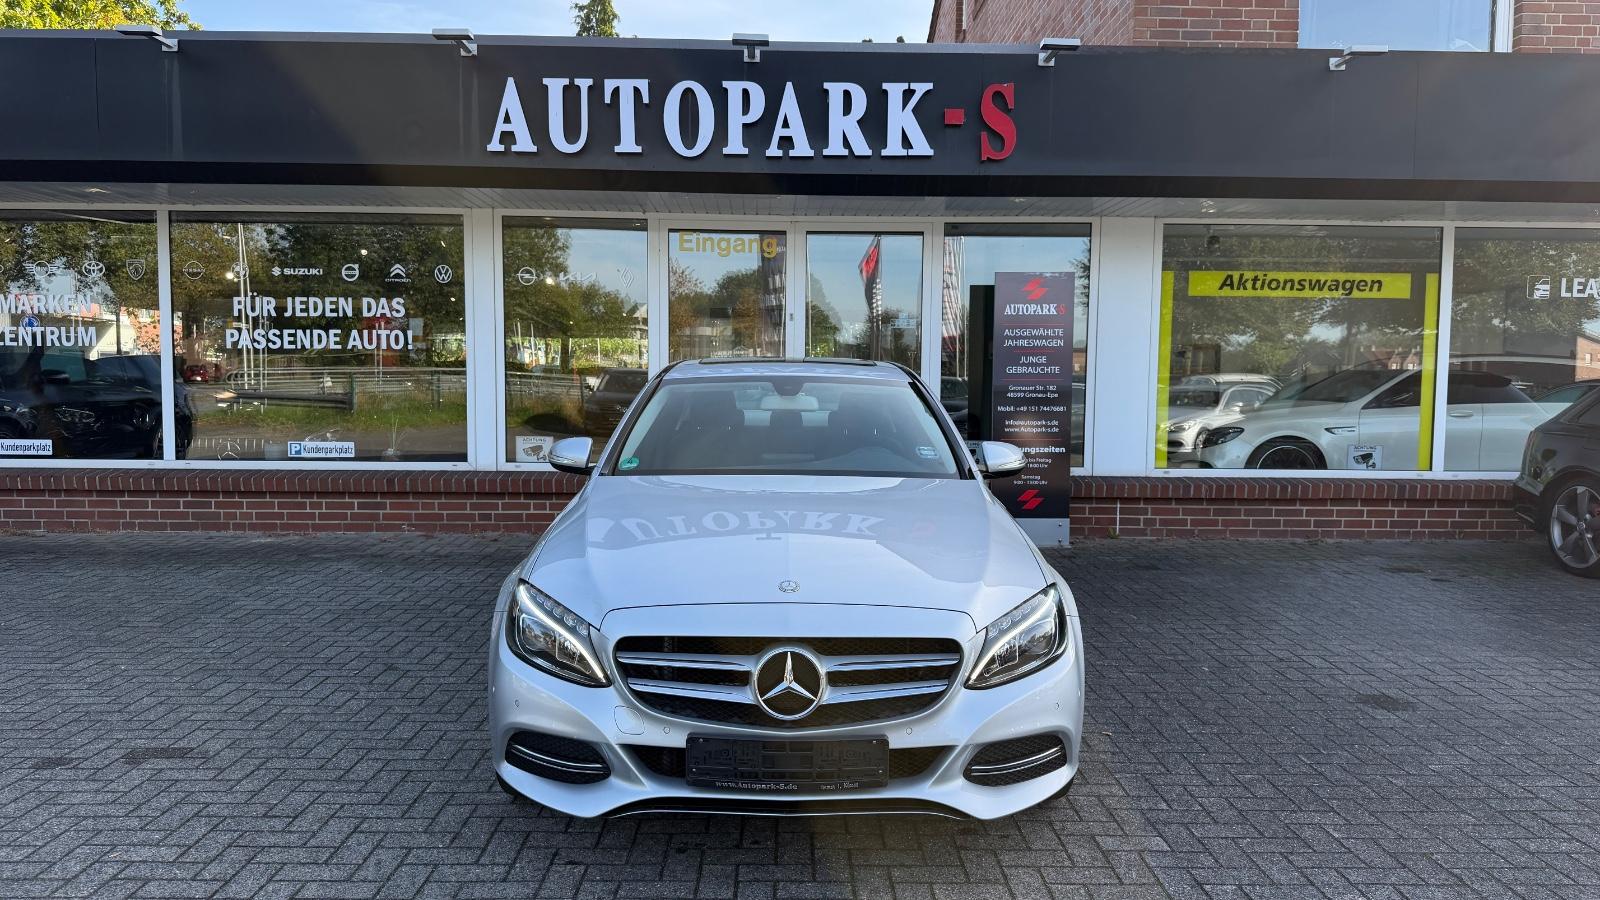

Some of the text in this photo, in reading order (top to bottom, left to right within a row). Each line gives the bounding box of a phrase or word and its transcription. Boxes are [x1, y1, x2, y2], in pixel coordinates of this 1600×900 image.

[679, 231, 778, 258] Eingang
[283, 266, 323, 276] SUZUKI
[1218, 272, 1383, 297] Aktionswagen
[1561, 277, 1600, 299] LEA
[233, 292, 406, 318] FÜR JEDEN DAS
[1004, 327, 1064, 336] AUSGEWÄHLTE
[226, 329, 413, 350] PASSENDE AUTO!
[1003, 339, 1064, 347] JAHRESWAGEN
[1019, 355, 1047, 363] JUNGE
[1006, 366, 1060, 374] GEBRAUCHTE
[0, 442, 51, 454] Kundenparkplatz
[303, 445, 353, 456] Kundenparkplatz
[1019, 445, 1066, 454] ungszeiten
